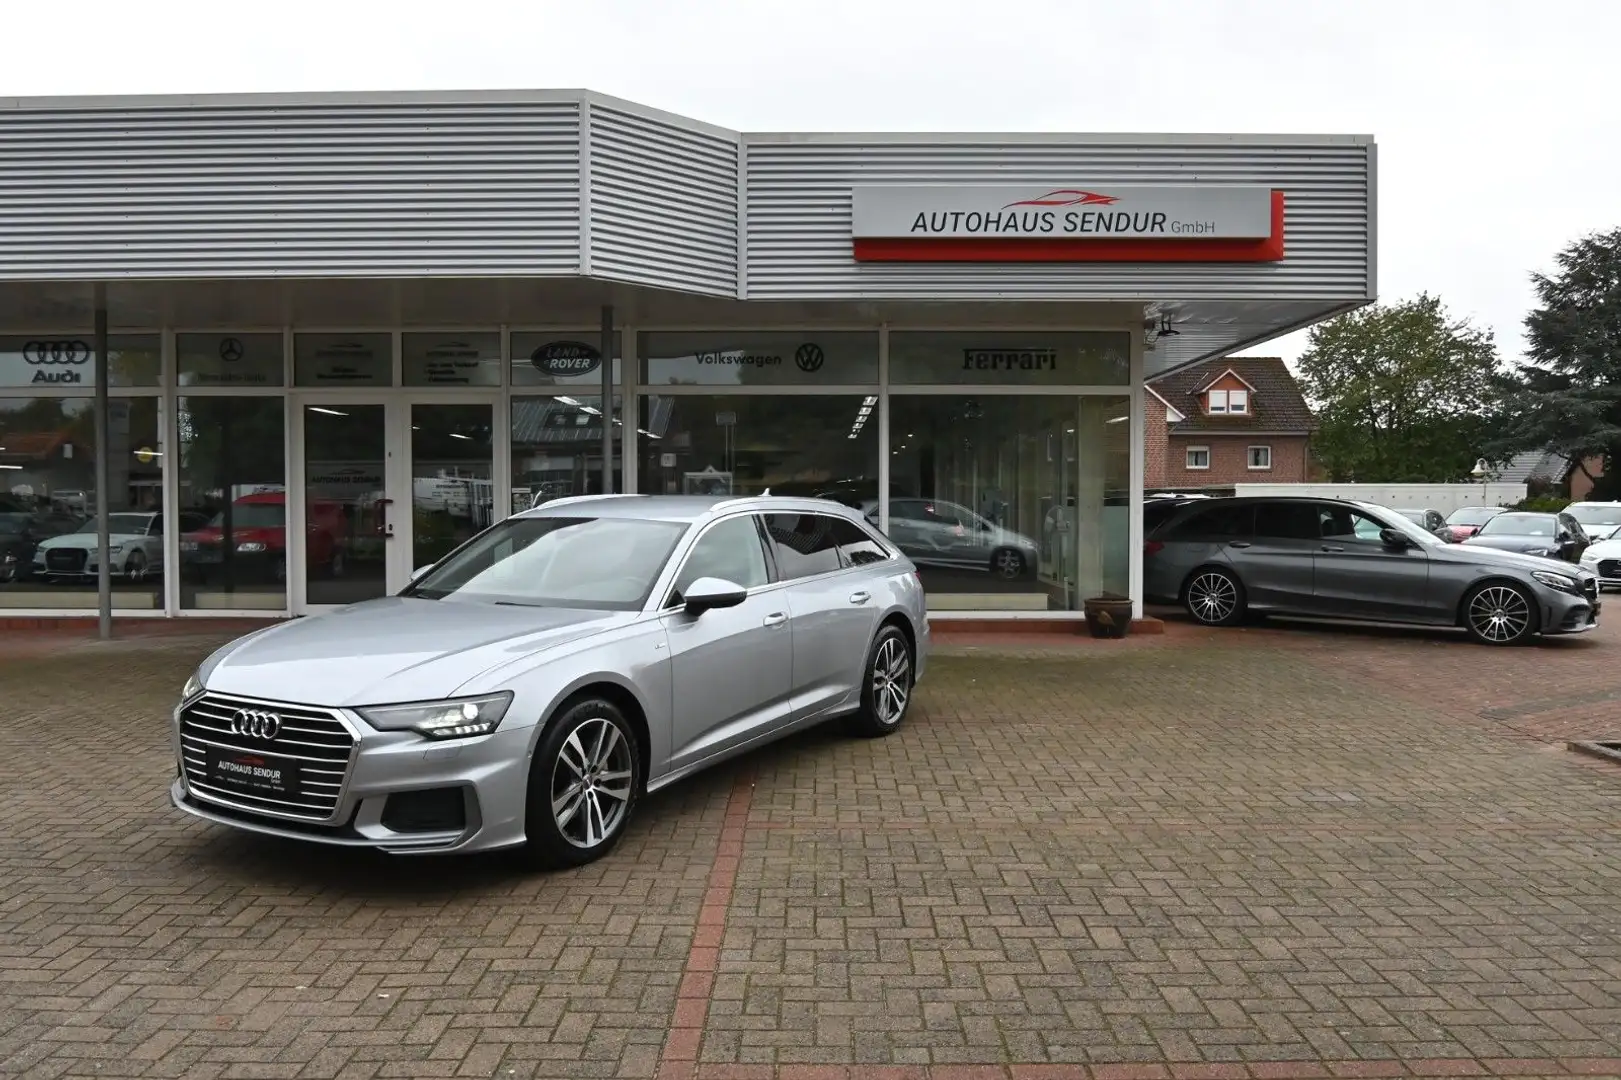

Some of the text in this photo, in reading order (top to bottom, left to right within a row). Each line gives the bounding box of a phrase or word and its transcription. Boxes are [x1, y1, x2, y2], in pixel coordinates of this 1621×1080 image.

[911, 211, 1215, 233] AUTOHAUS SENDUR GmbH
[546, 347, 580, 358] LAND
[694, 351, 782, 368] Volkswagen
[962, 348, 1058, 370] Ferrari
[549, 358, 591, 369] ROVER
[31, 369, 81, 384] Audi
[217, 760, 281, 779] AUTOHAUS SENDUR
